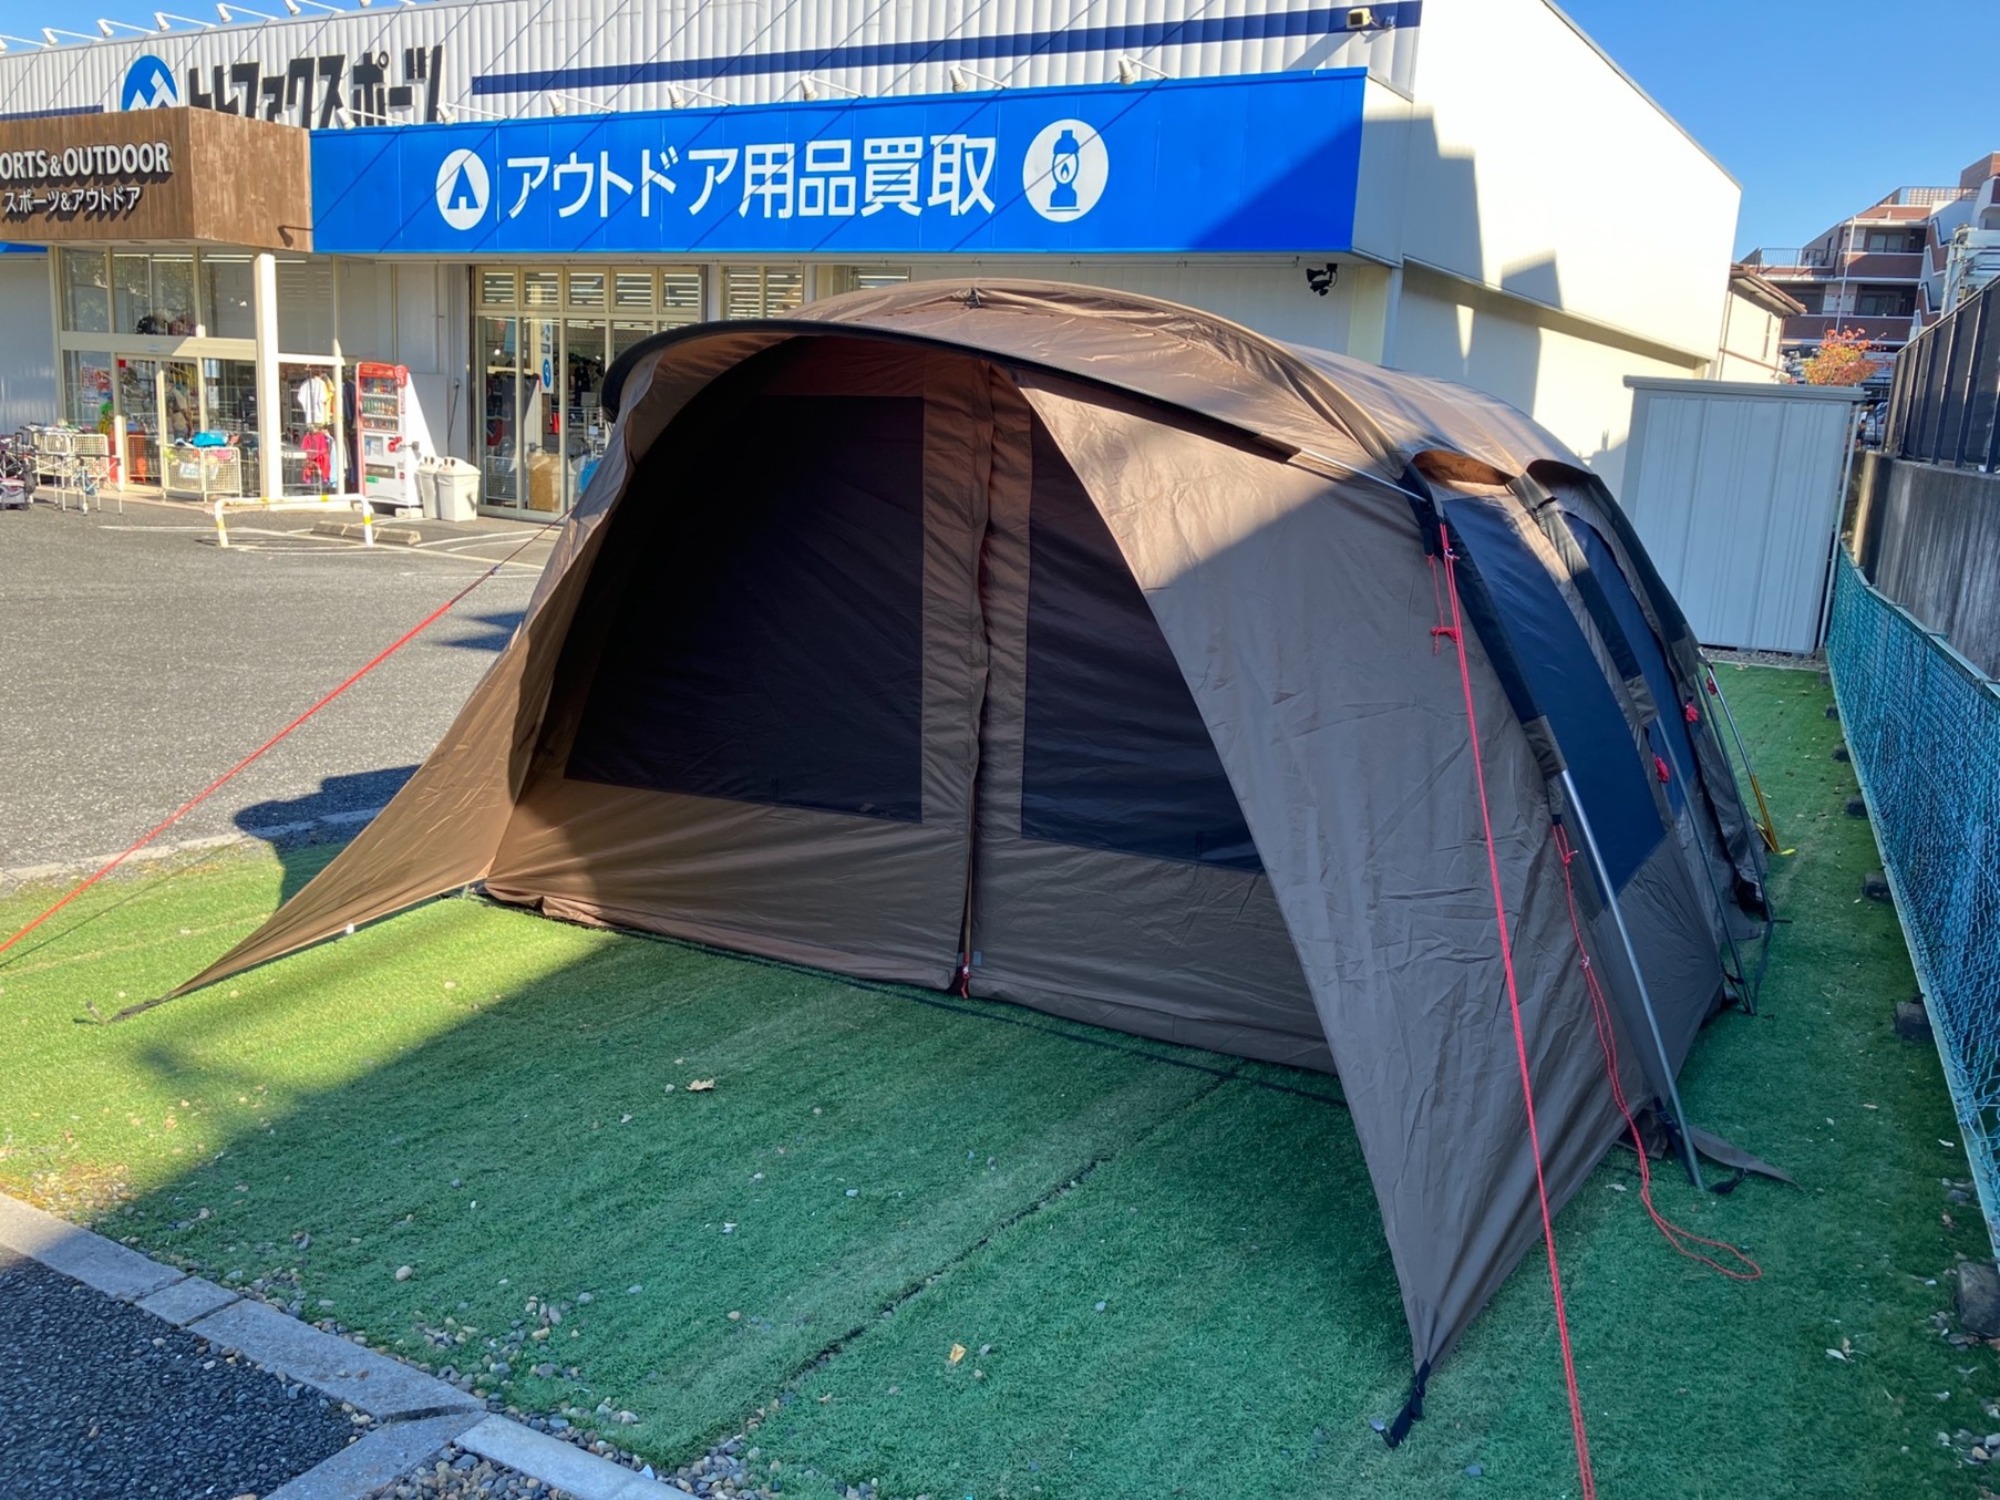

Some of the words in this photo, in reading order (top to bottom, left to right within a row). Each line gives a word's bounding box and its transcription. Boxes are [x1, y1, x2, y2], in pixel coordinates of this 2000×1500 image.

[5, 186, 141, 214] スポーツ&アウトドア
[506, 134, 996, 219] アウトドア用品買取
